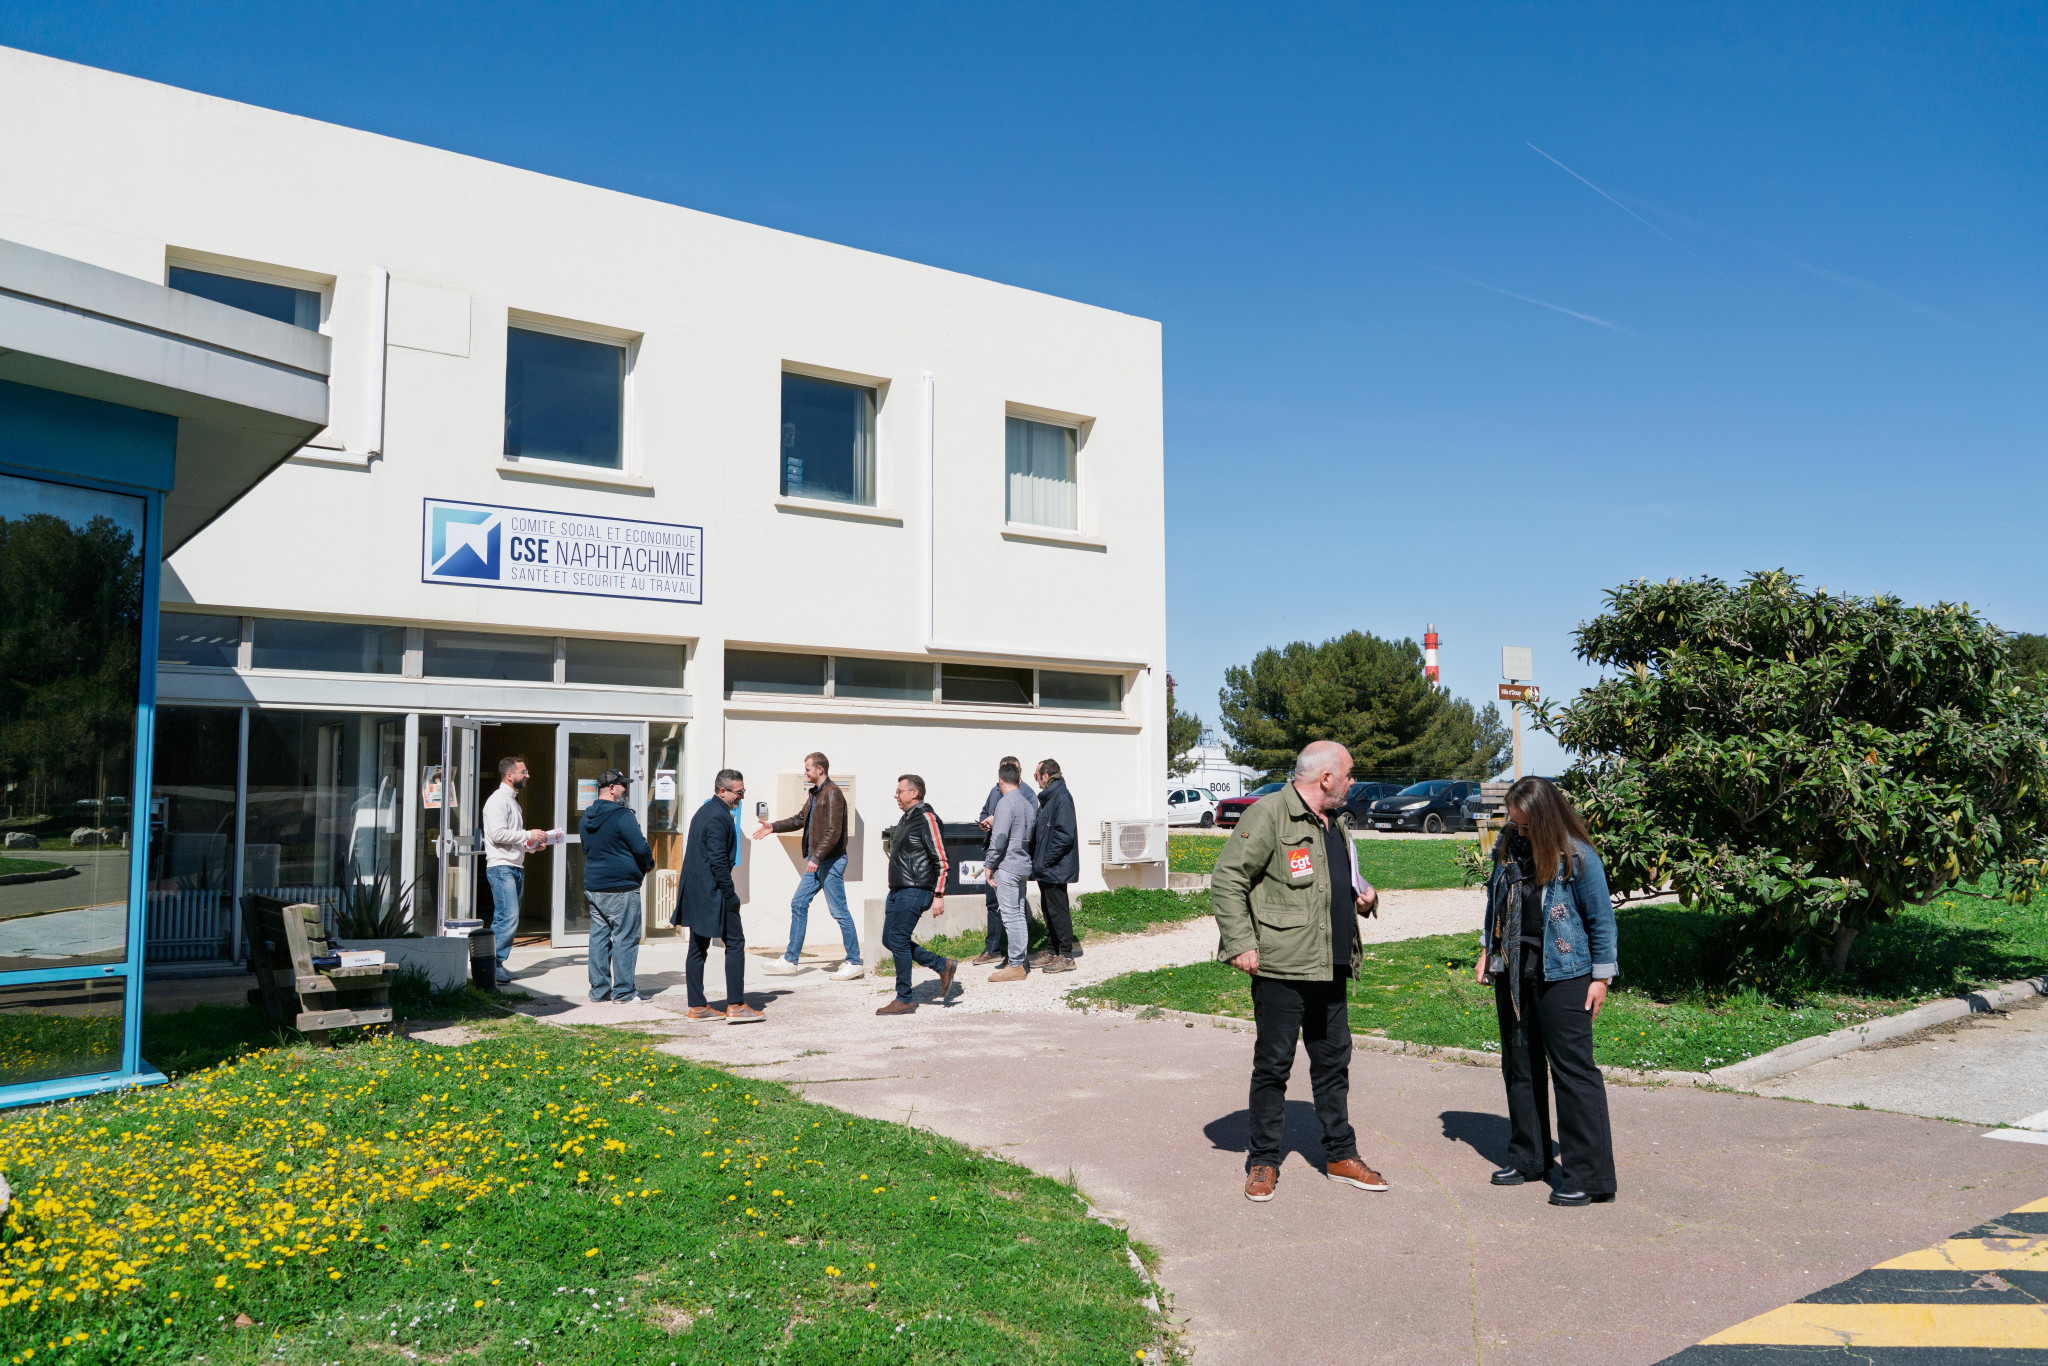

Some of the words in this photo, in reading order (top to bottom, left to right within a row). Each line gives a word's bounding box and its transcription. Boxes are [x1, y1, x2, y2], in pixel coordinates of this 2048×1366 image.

[561, 522, 602, 539] SOCIAL
[607, 527, 620, 541] ET
[626, 529, 695, 548] ECONOMIQUE
[511, 536, 549, 563] CSE
[556, 541, 696, 576] NAPHTACHIMIE
[555, 571, 568, 584] ET
[631, 577, 645, 591] AU
[650, 579, 695, 595] TRAVAIL
[1290, 854, 1311, 870] cgt
